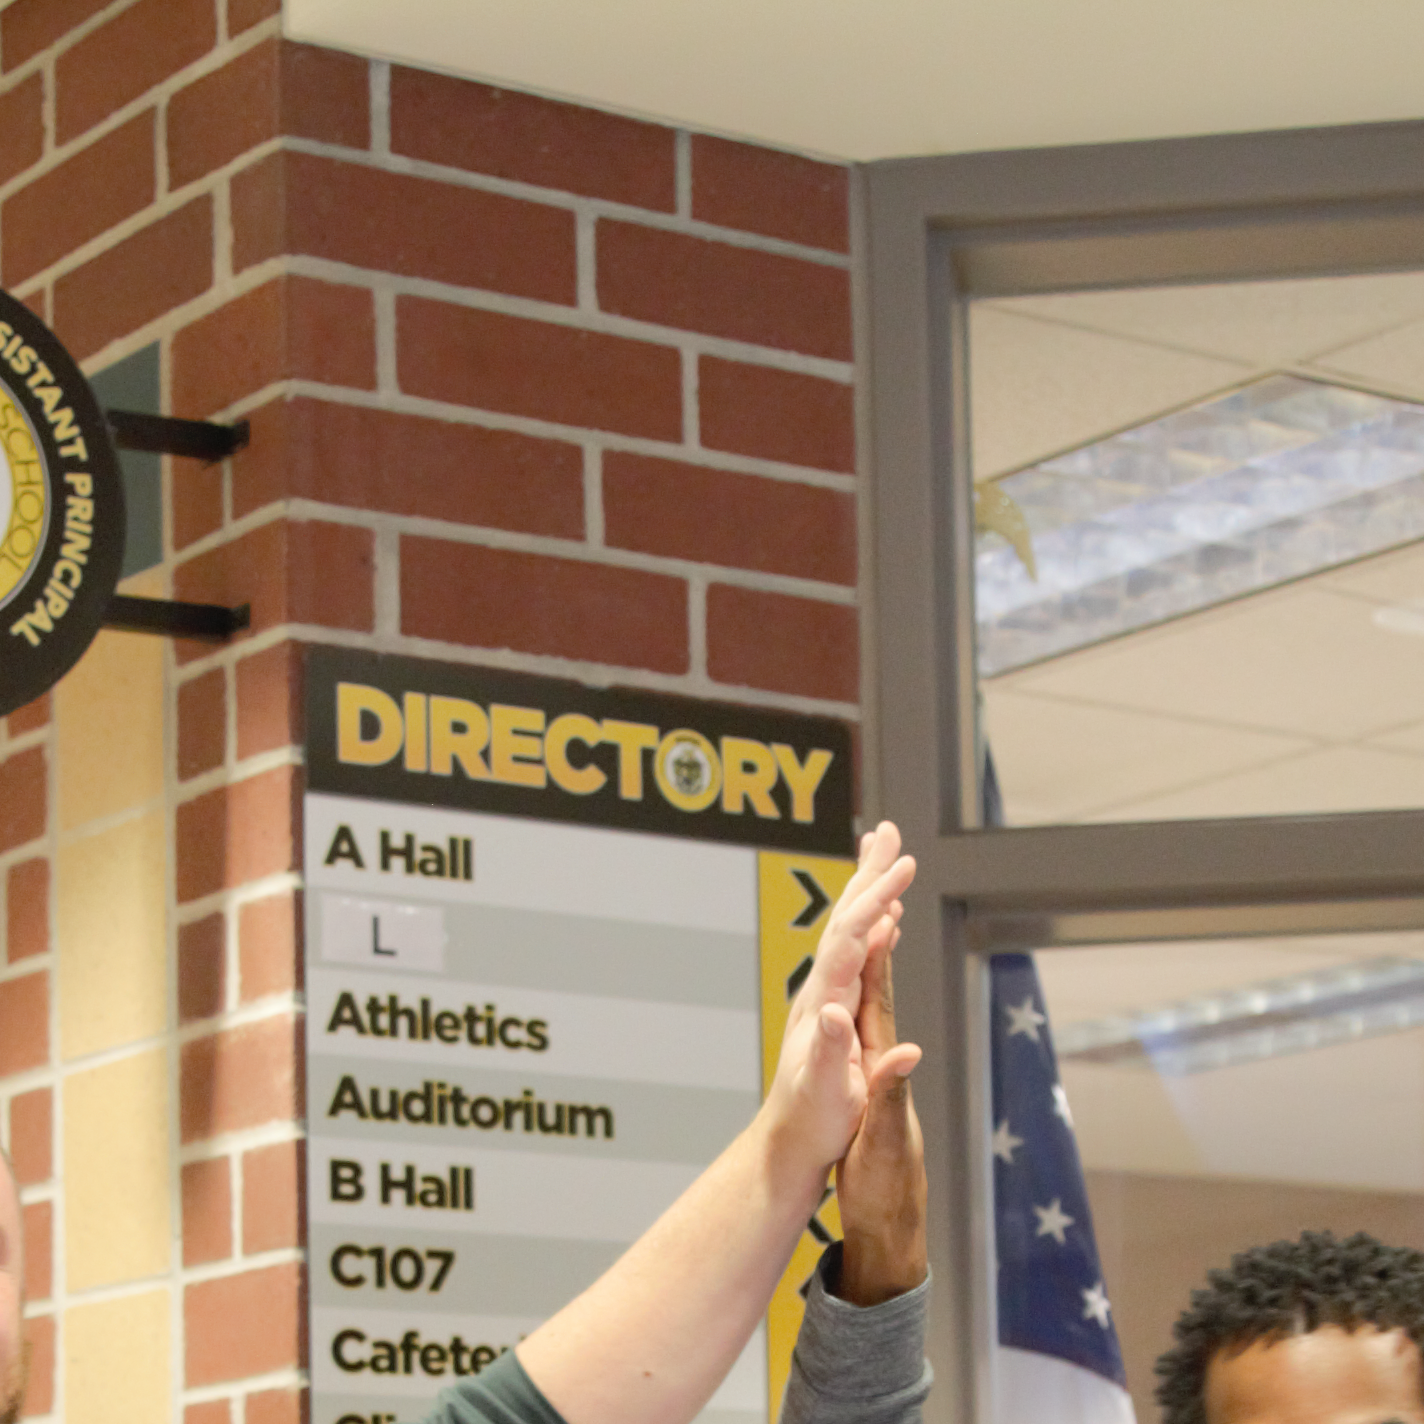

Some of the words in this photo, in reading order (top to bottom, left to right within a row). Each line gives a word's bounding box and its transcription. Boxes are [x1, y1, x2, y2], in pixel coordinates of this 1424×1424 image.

[10, 472, 94, 646] PRINCIPAL
[336, 681, 833, 823] DIRECTORY
[324, 825, 364, 869] A
[379, 830, 474, 881] Hall
[373, 915, 397, 956] L
[327, 991, 551, 1053] Athletics
[327, 1075, 613, 1139] Auditorium
[329, 1160, 364, 1202] B
[380, 1163, 474, 1210] Hall
[329, 1244, 455, 1291] C107
[331, 1328, 513, 1377] Cafete
